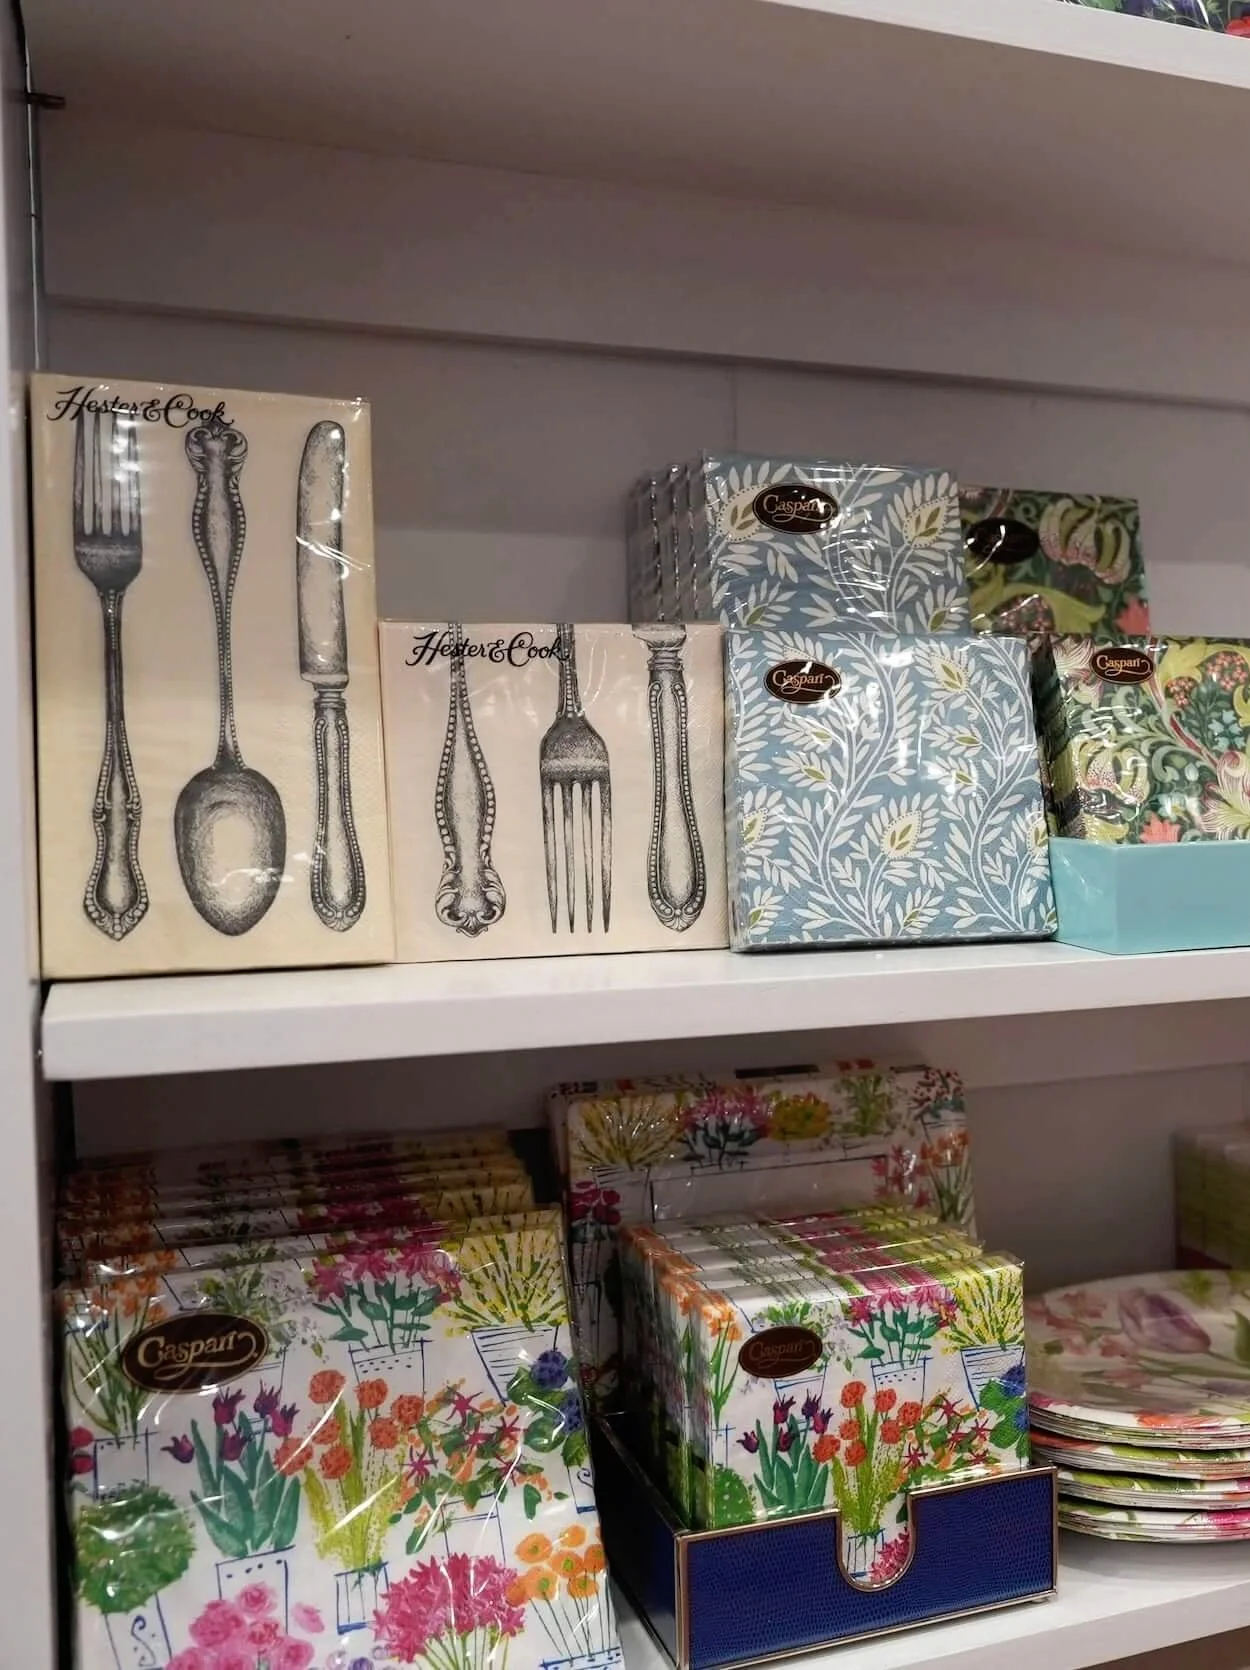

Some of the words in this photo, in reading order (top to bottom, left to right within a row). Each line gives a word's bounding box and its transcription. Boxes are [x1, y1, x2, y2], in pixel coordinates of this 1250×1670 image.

[1096, 655, 1152, 681] Caspari
[773, 670, 836, 695] Caspari
[137, 1331, 258, 1380] Caspari
